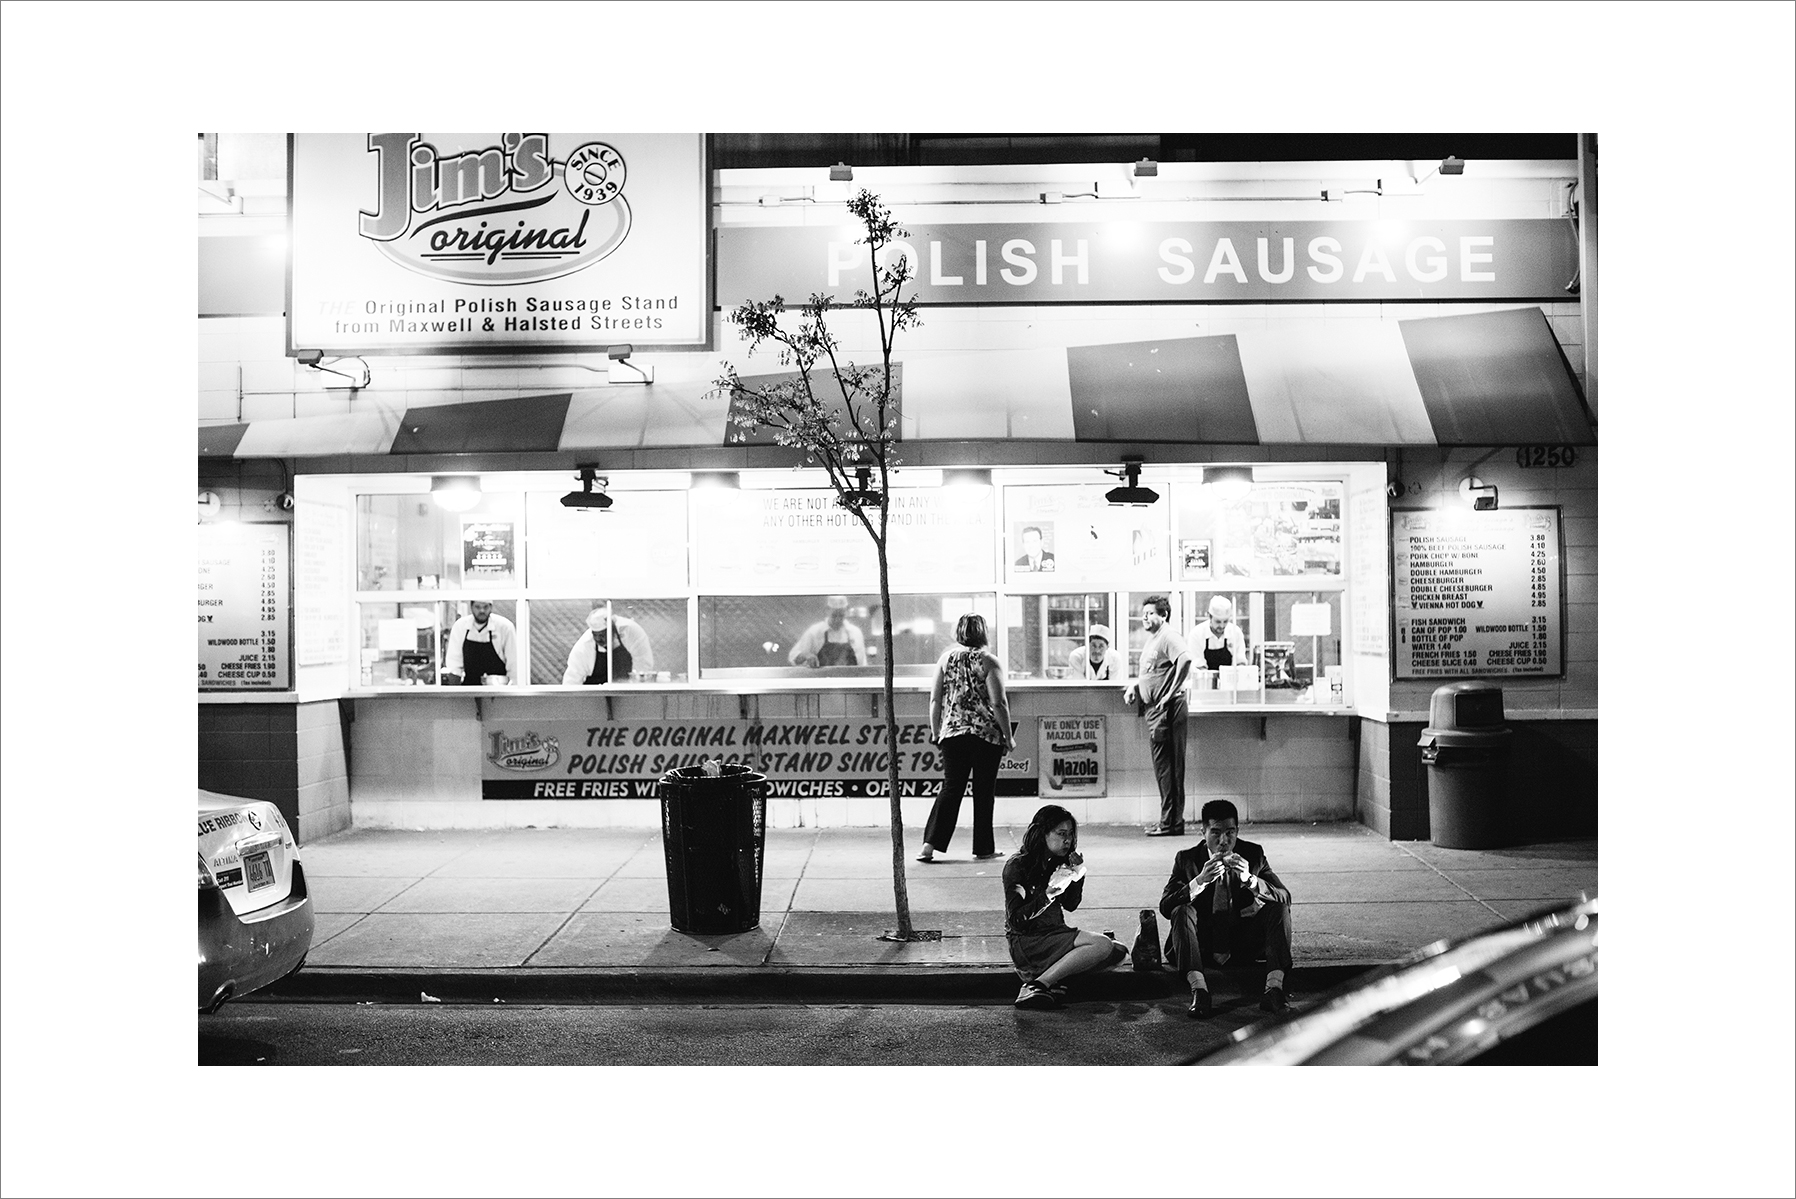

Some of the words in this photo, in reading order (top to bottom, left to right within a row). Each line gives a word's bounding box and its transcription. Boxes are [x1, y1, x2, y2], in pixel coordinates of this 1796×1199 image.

[571, 147, 621, 171] SINCE
[359, 133, 554, 242] Jim's
[574, 181, 618, 201] 1939
[431, 208, 590, 265] original
[828, 239, 1089, 286] POLISH
[1157, 236, 1496, 284] SAUSAGE
[365, 299, 445, 316] Original
[455, 298, 517, 312] Polish
[526, 297, 612, 313] Sausage
[621, 296, 678, 310] Stand
[335, 320, 379, 333] from
[390, 318, 472, 333] Maxwell
[482, 317, 495, 332] &
[504, 316, 581, 331] Halsted
[591, 315, 663, 329] Streets
[763, 498, 779, 510] WE
[783, 497, 803, 510] ARE
[806, 497, 828, 510] NOT
[895, 497, 905, 509] IN
[909, 497, 928, 509] ANY
[763, 516, 784, 527] ANY
[788, 515, 823, 527] OTHER
[826, 514, 848, 527] HOT
[878, 514, 913, 526] SAND
[916, 513, 927, 526] IN
[1440, 568, 1483, 576] HAMBURGER
[1411, 577, 1464, 585] CHEESEBURGER
[1461, 601, 1476, 609] DOG
[261, 630, 276, 638] 3.15
[1438, 626, 1452, 634] POP
[1532, 624, 1547, 632] 1.50
[239, 638, 258, 646] BOTTLE
[261, 638, 276, 646] 1.50
[1411, 635, 1437, 643] BOTTLE
[1412, 643, 1435, 651] WATER
[1509, 641, 1529, 649] JUICE
[1532, 641, 1547, 649] 2.15
[239, 654, 258, 662] JUICE
[261, 654, 276, 662] 2.15
[1412, 651, 1439, 659] FRENCH
[1441, 651, 1461, 659] FRIES
[1464, 650, 1477, 658] 1.50
[1489, 650, 1512, 658] CHEESE
[221, 662, 243, 670] CHEESE
[1412, 659, 1440, 667] CHEESE
[1442, 659, 1462, 667] SLICE
[1487, 658, 1514, 666] CHEESE
[218, 671, 245, 679] CHEESE
[246, 671, 261, 679] CUP
[261, 671, 276, 679] 0.50
[1044, 720, 1057, 730] WE
[1060, 720, 1081, 730] ONLY
[1083, 720, 1100, 730] USE
[587, 727, 629, 747] THE
[632, 726, 736, 747] ORIGINAL
[742, 724, 850, 746] MAXWELL
[1047, 731, 1081, 740] MAZOLA
[1084, 731, 1097, 740] OIL
[567, 754, 647, 774] POLISH
[758, 752, 832, 773] STAND
[910, 751, 947, 772] 193
[1007, 760, 1029, 772] Beef
[1053, 758, 1099, 777] Mazola
[534, 782, 576, 797] FREE
[581, 781, 629, 797] FRIES
[635, 781, 660, 797] WI
[766, 780, 844, 797] DWICHES
[866, 780, 916, 796] OPN
[198, 820, 217, 837] LUE
[216, 811, 248, 830] RIBBON
